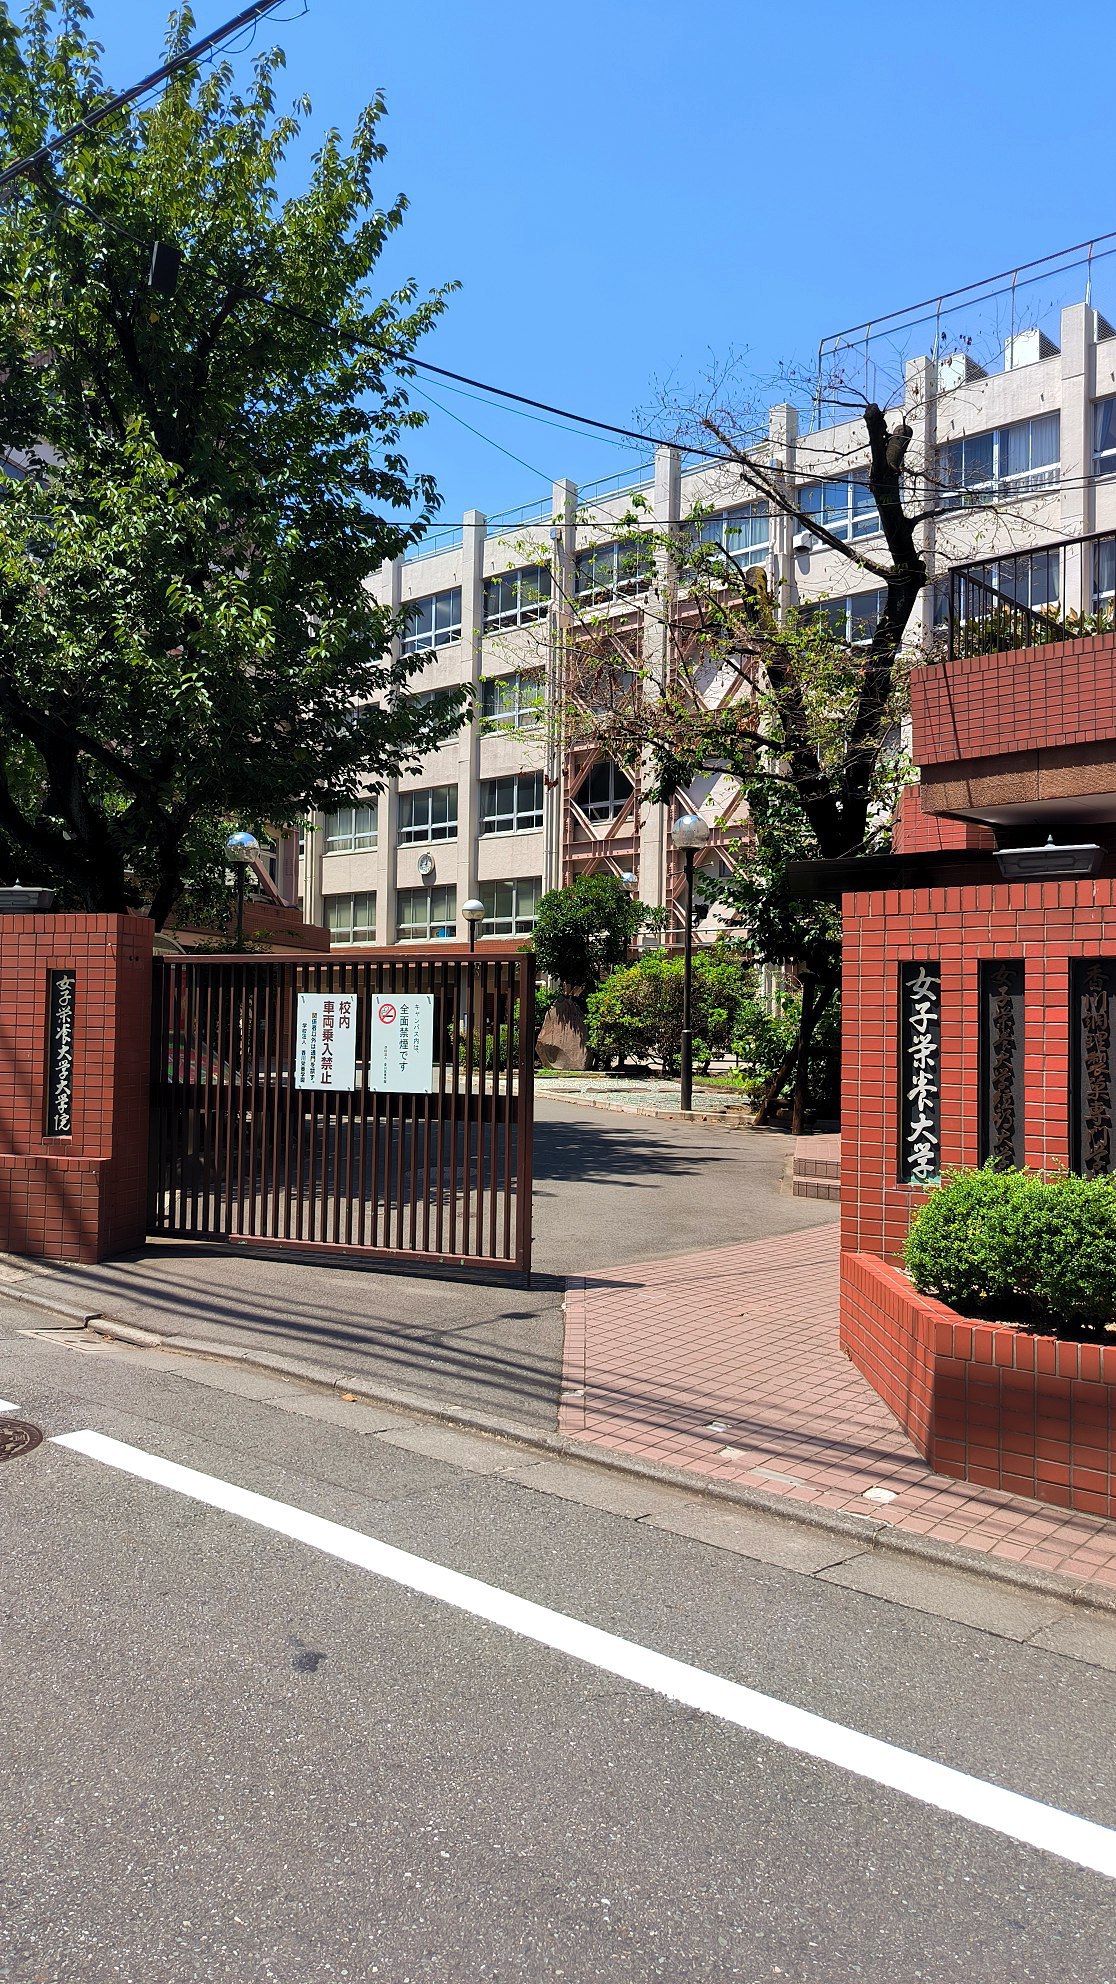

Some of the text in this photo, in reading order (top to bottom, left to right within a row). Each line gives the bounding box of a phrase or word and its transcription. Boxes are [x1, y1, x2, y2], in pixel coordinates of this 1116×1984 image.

[54, 974, 76, 1131] 女子栄養大学大学院
[320, 1000, 335, 1085] 車両乗入禁止
[339, 1000, 351, 1029] 校内
[398, 1003, 410, 1072] 全面禁煙です
[905, 966, 941, 1178] 女子栄養大学
[1083, 965, 1111, 1177] 香川調理製菓専門学
